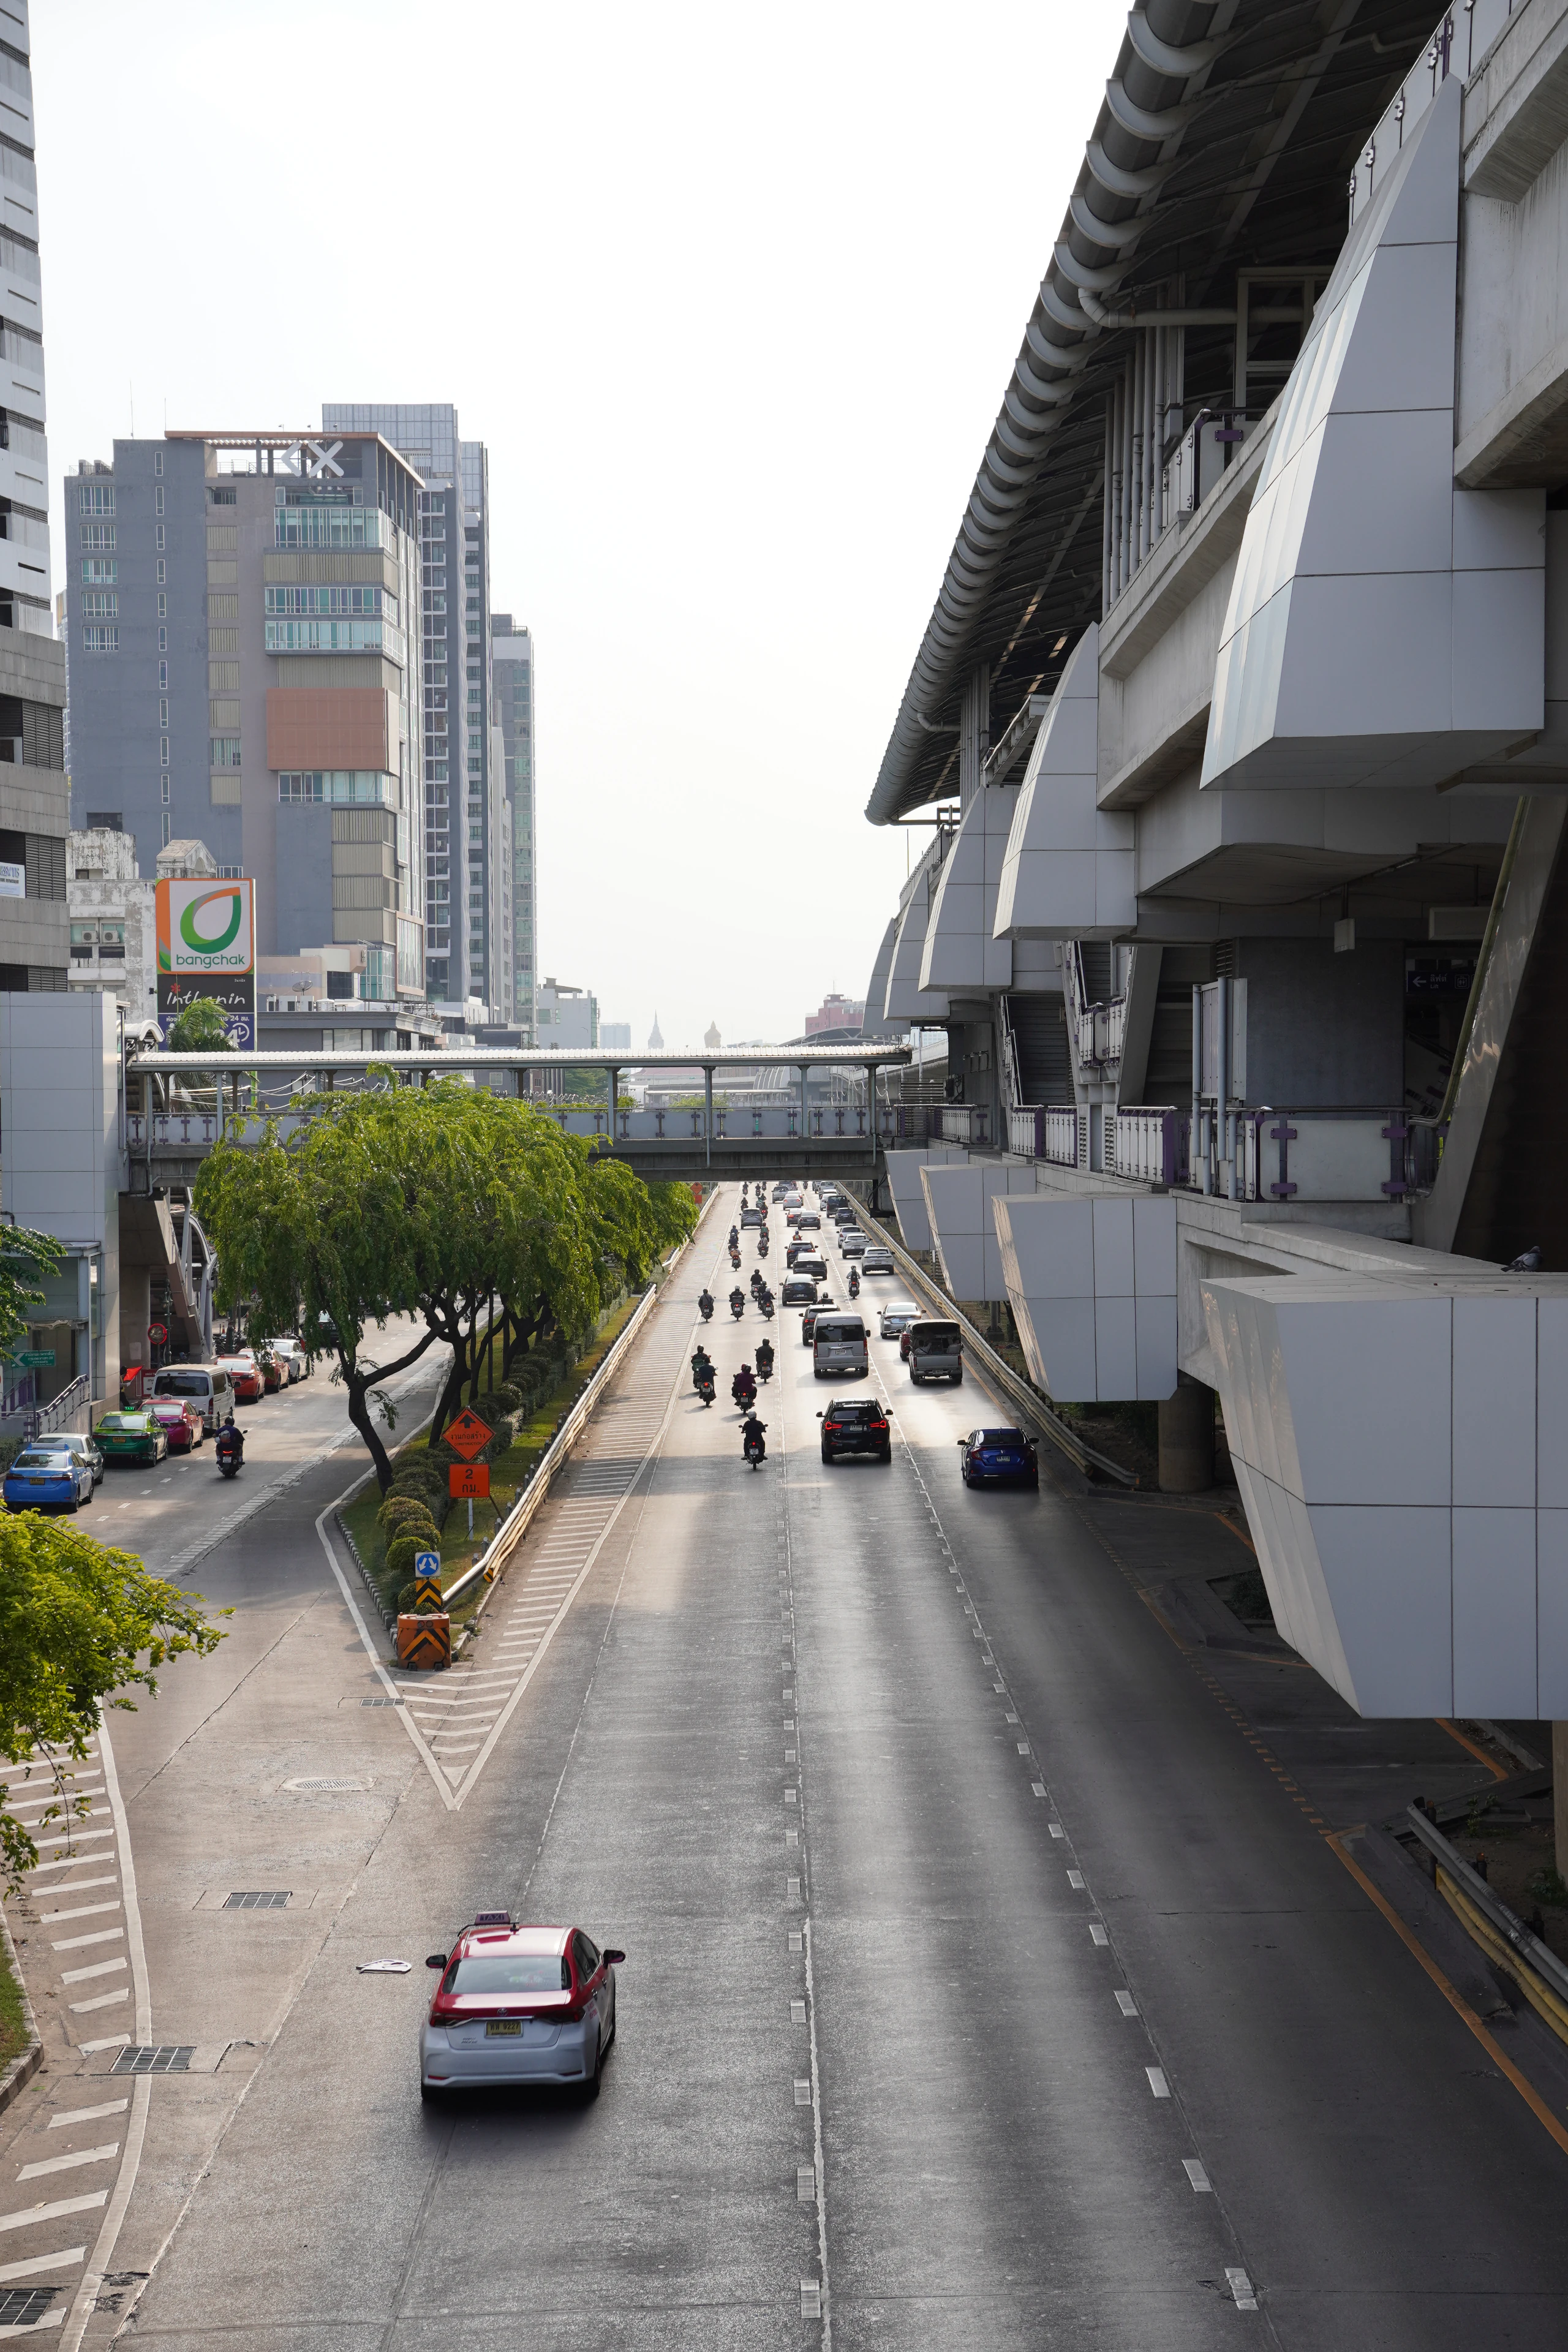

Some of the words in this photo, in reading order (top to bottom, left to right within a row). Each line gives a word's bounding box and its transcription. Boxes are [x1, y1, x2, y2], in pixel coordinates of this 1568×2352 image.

[176, 954, 245, 968] bangchak
[1430, 973, 1447, 982] ลิฟต์
[450, 1431, 486, 1440] งานก่อสร้าง
[465, 1468, 473, 1479] 2
[462, 1483, 480, 1493] กม.
